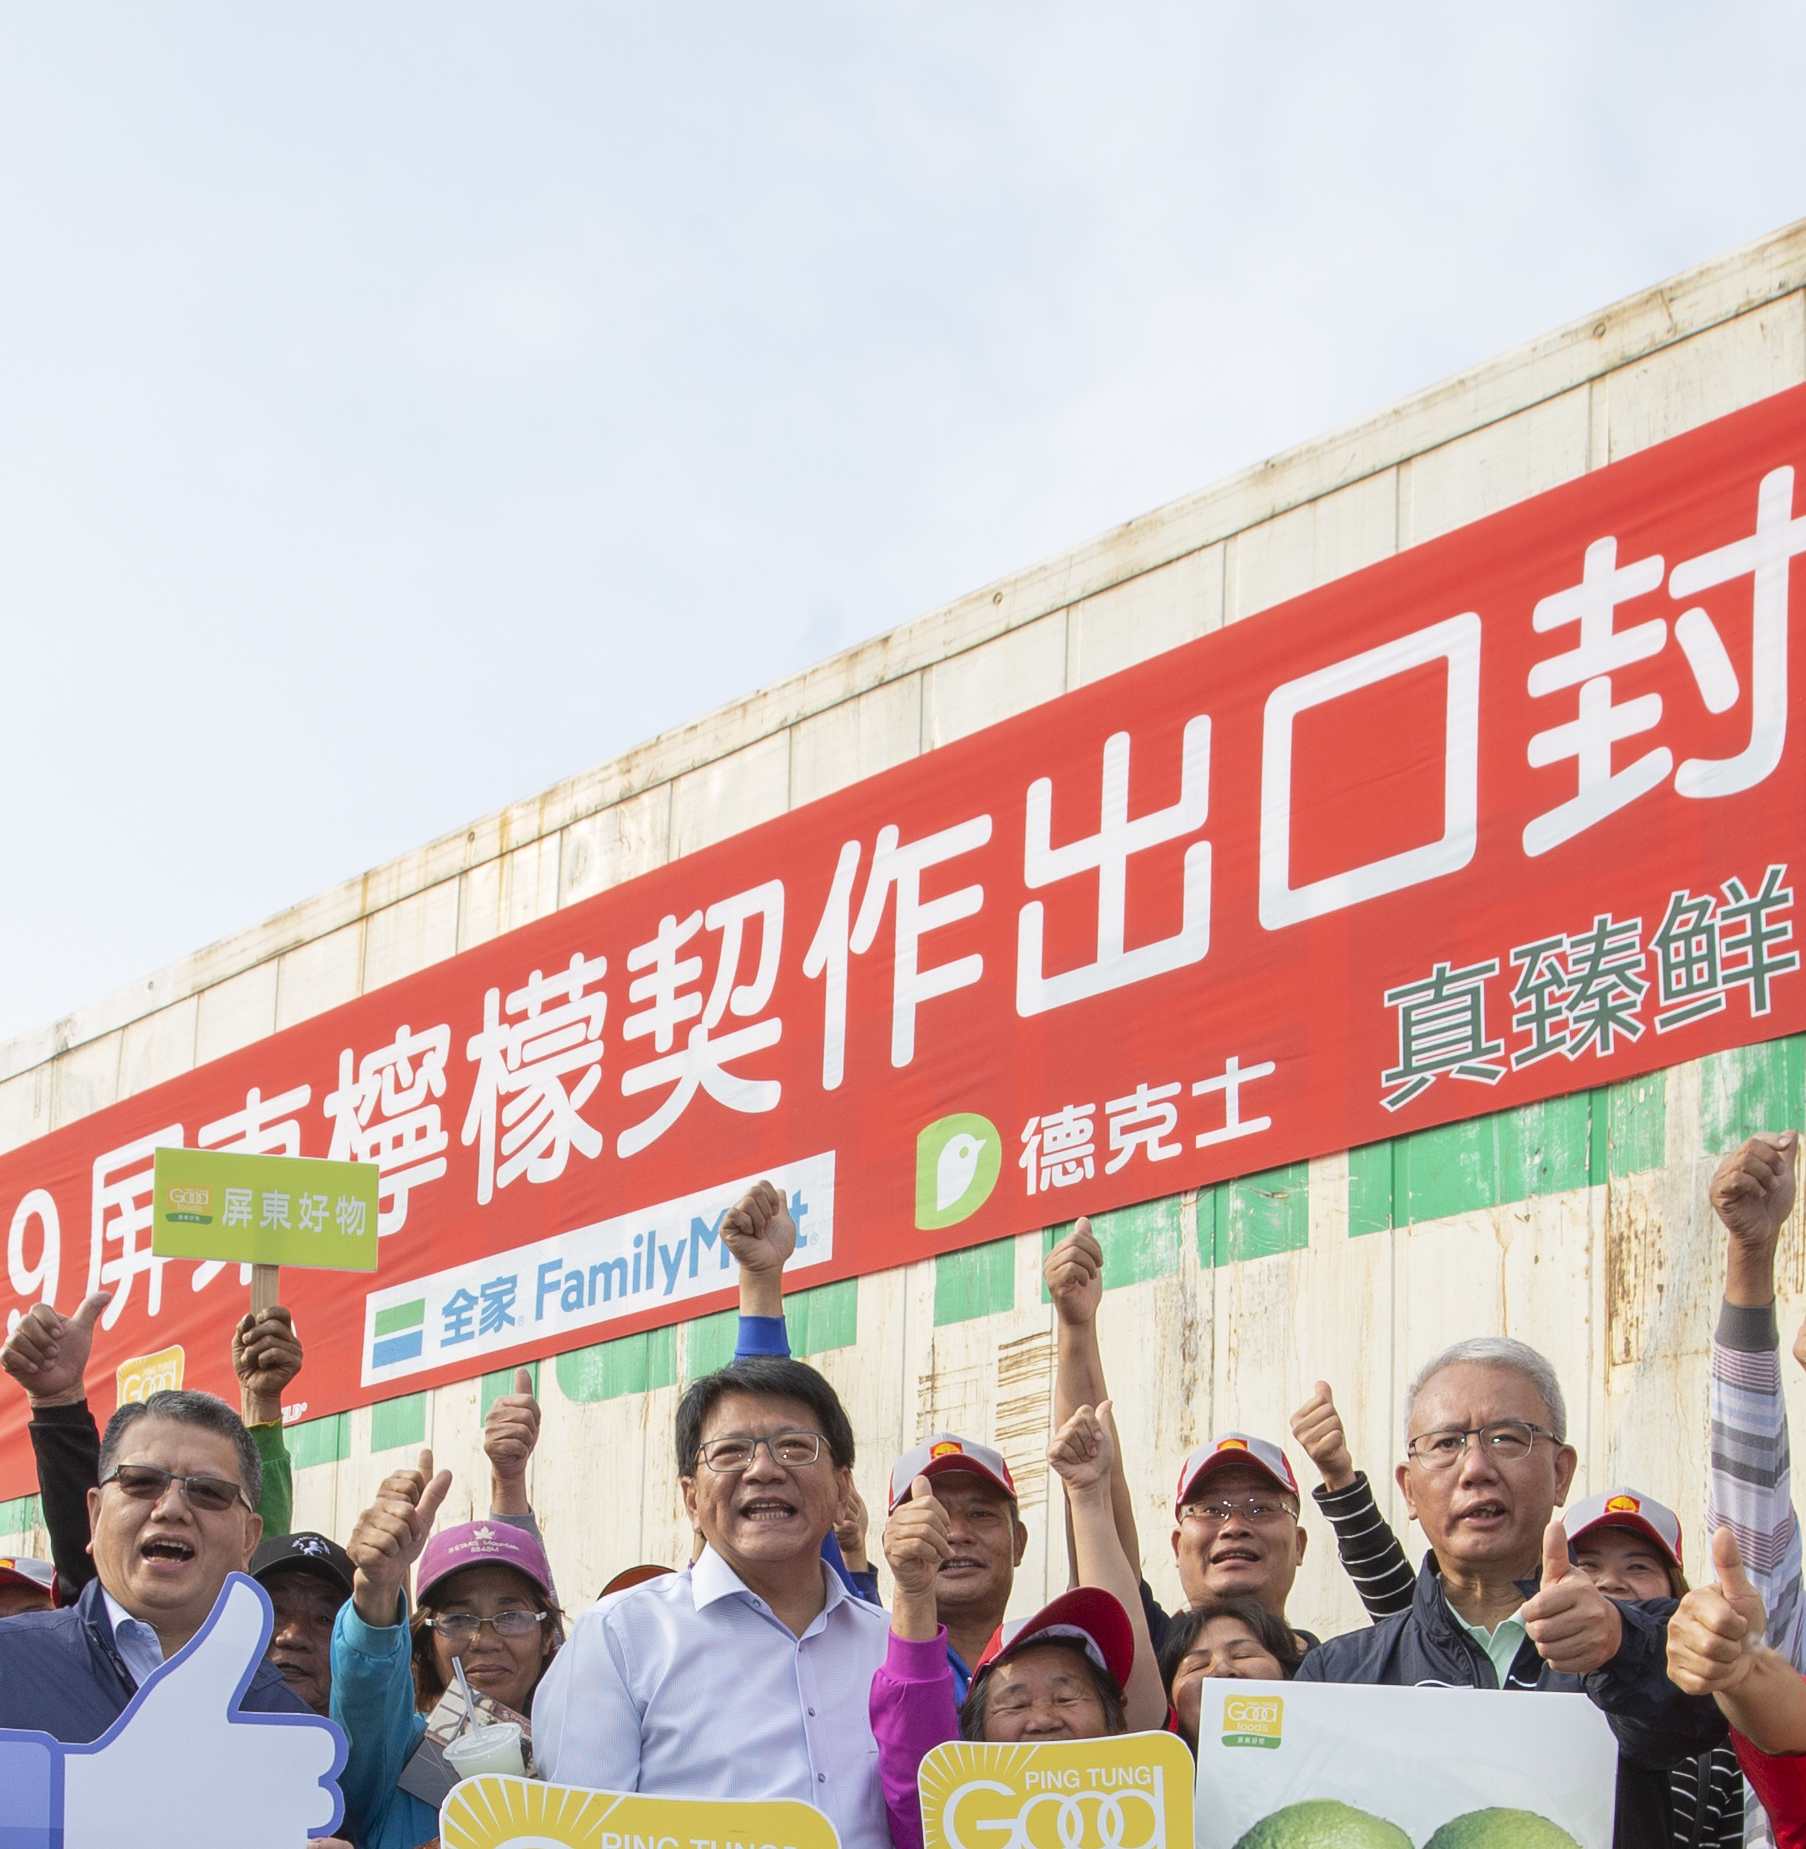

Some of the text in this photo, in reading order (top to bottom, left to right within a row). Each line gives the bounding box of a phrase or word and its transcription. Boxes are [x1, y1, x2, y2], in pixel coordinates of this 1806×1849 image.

[1380, 864, 1800, 1113] 真臻鲜
[1018, 1055, 1276, 1196] 德克士
[221, 1187, 367, 1236] 屏東好物
[440, 1188, 809, 1348] 全家 FamilyMt
[1227, 1701, 1278, 1723] Good
[1024, 1765, 1152, 1790] PING TUNG
